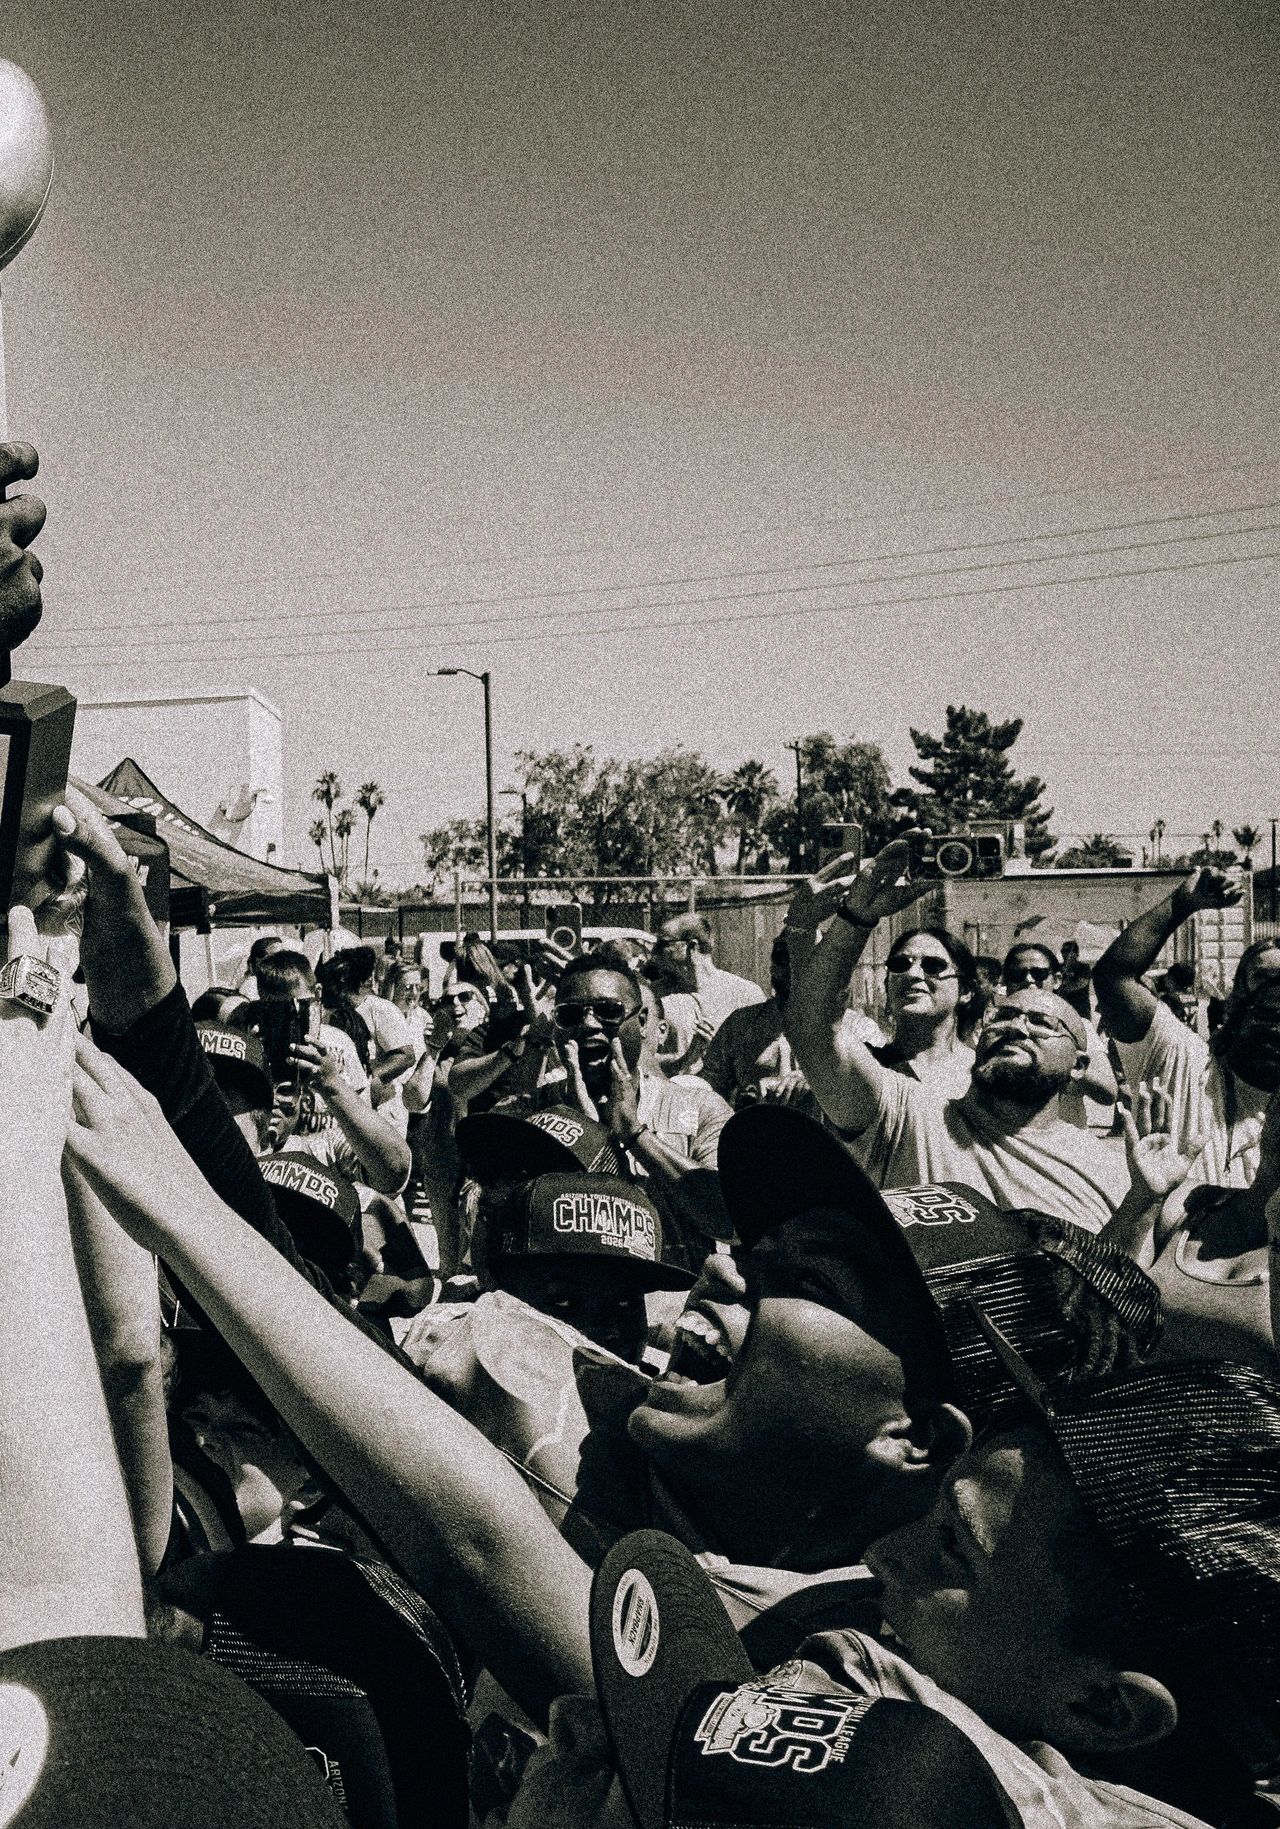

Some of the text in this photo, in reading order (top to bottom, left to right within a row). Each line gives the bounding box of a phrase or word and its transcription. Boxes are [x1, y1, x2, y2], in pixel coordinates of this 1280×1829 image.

[553, 1197, 656, 1252] CHAMPS
[627, 1595, 644, 1647] SNAPBACK
[328, 1760, 349, 1811] ARIZON
